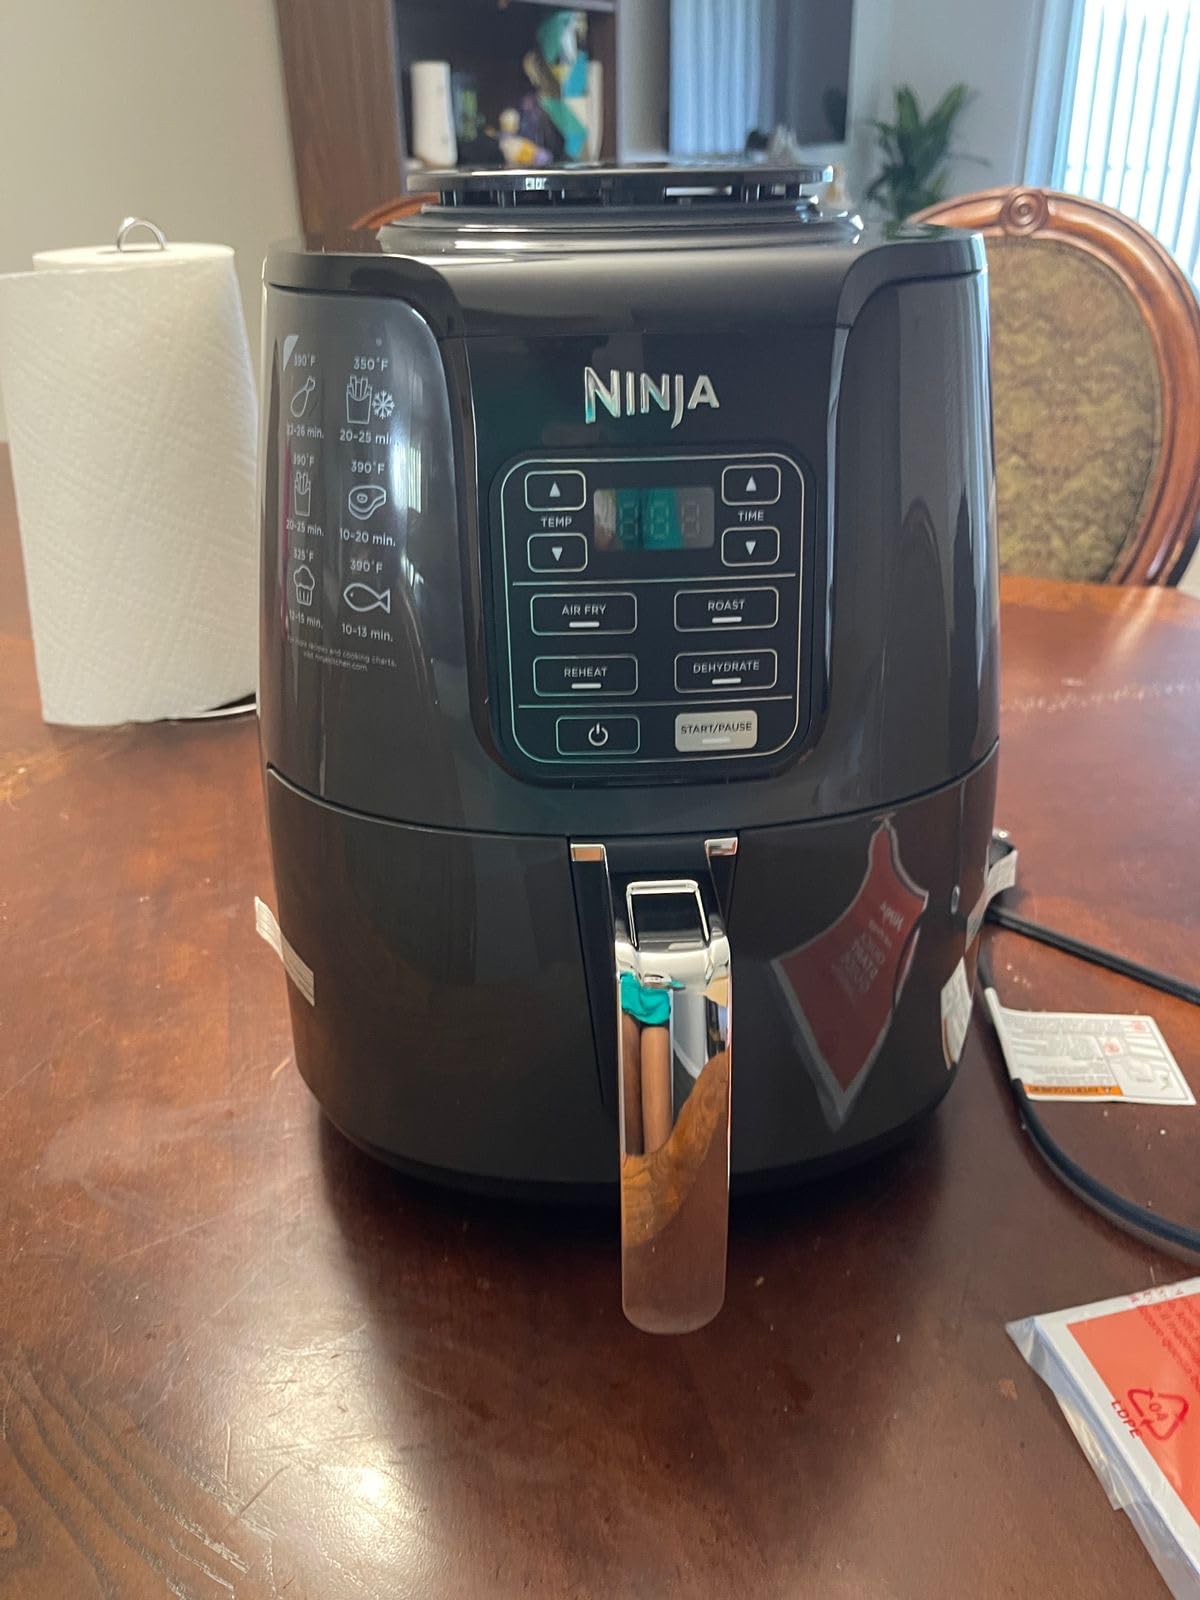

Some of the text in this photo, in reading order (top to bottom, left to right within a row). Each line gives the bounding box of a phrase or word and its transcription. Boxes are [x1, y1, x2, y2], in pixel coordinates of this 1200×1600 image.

[584, 366, 720, 430] NINJA
[541, 516, 573, 528] TEMP
[737, 511, 765, 522] TIME
[339, 527, 396, 547] 10-20 min.
[561, 603, 607, 616] AIR FRY
[707, 599, 746, 611] ROAST
[370, 627, 394, 643] min.
[563, 666, 608, 678] REHEAT
[692, 660, 761, 674] DEHYDRATE
[680, 721, 753, 735] START/PAUSE
